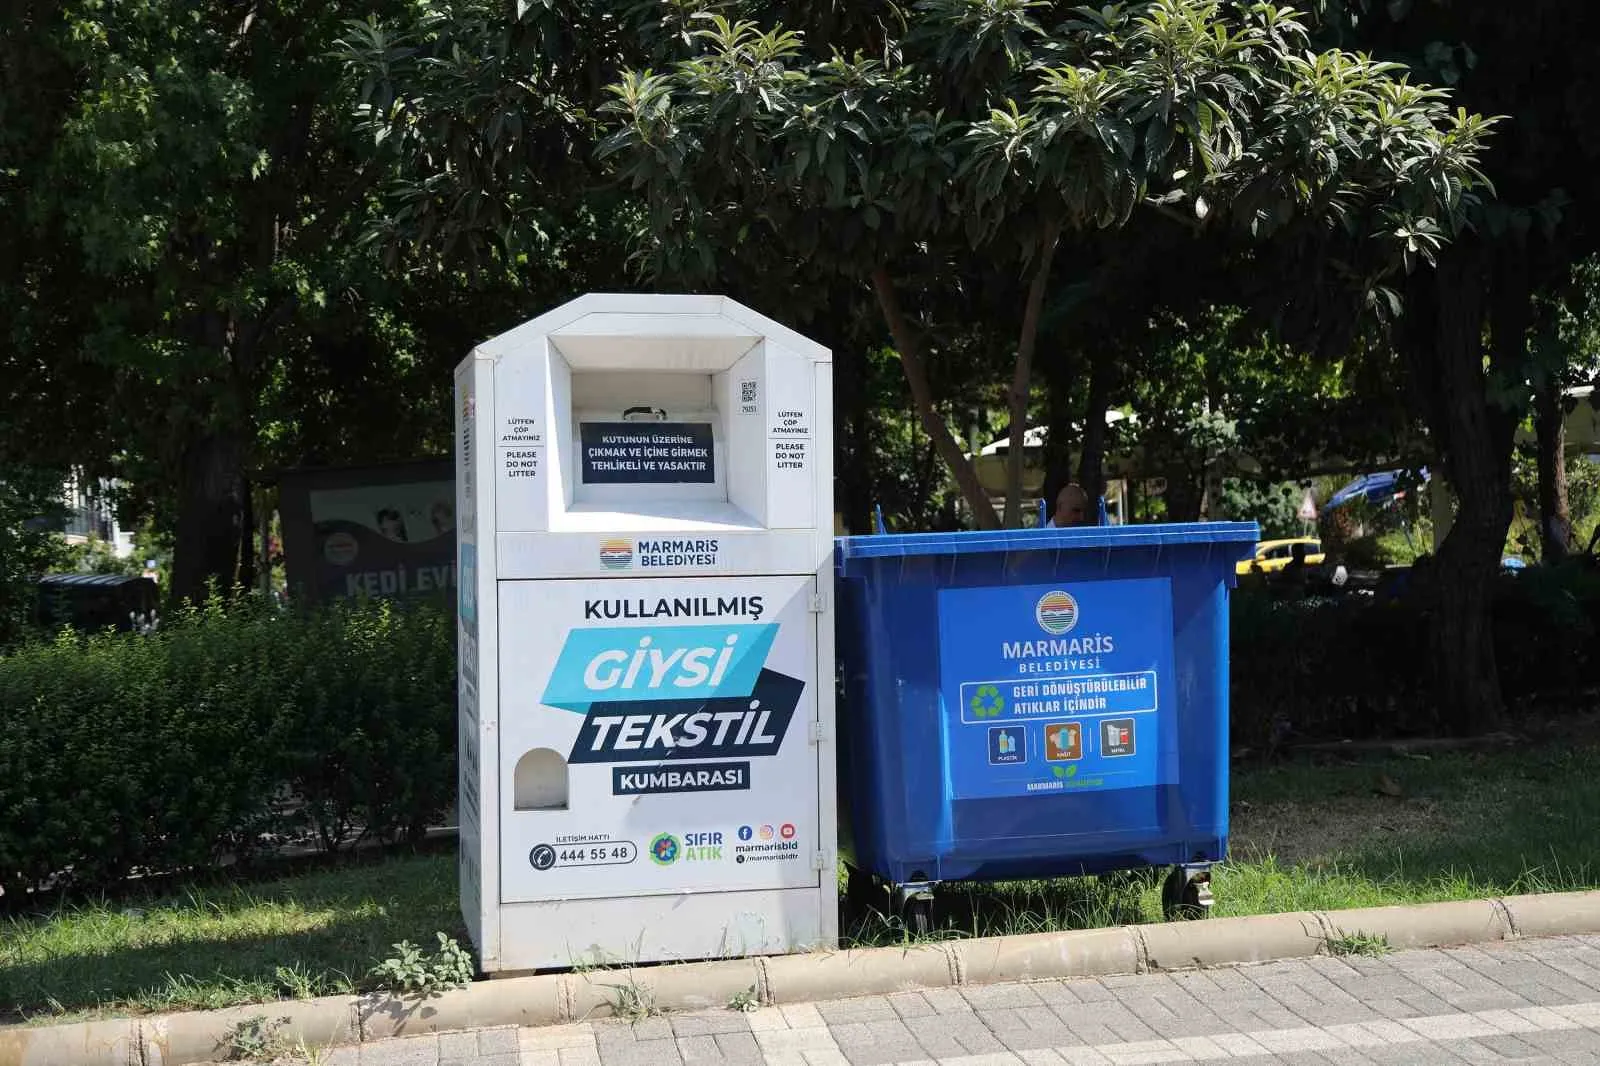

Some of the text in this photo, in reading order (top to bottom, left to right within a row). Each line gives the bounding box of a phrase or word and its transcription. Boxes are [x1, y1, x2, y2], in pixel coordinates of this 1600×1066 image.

[602, 434, 694, 444] KUTUNUN ÜZERİNE
[588, 446, 708, 459] ÇIKMAK VE İÇİNE GİRMEK
[591, 459, 706, 471] TEHLİKELİ VE YASAKTIR
[777, 461, 803, 469] LITTER
[584, 596, 764, 620] KULLANILMIŞ
[1002, 633, 1113, 660] MARMARİS
[583, 634, 739, 691] GİYSİ
[1019, 656, 1100, 673] BELEDİYESİ
[1013, 682, 1039, 698] GERİ
[1014, 696, 1106, 714] ATIKLAR İÇİNDİR
[591, 699, 776, 751] TEKSTİL
[620, 769, 743, 790] KUMBARASI
[685, 832, 723, 846] SIFIR
[736, 841, 798, 852] marmarisbld
[560, 847, 628, 861] 444 55 48
[686, 847, 722, 861] ATIK
